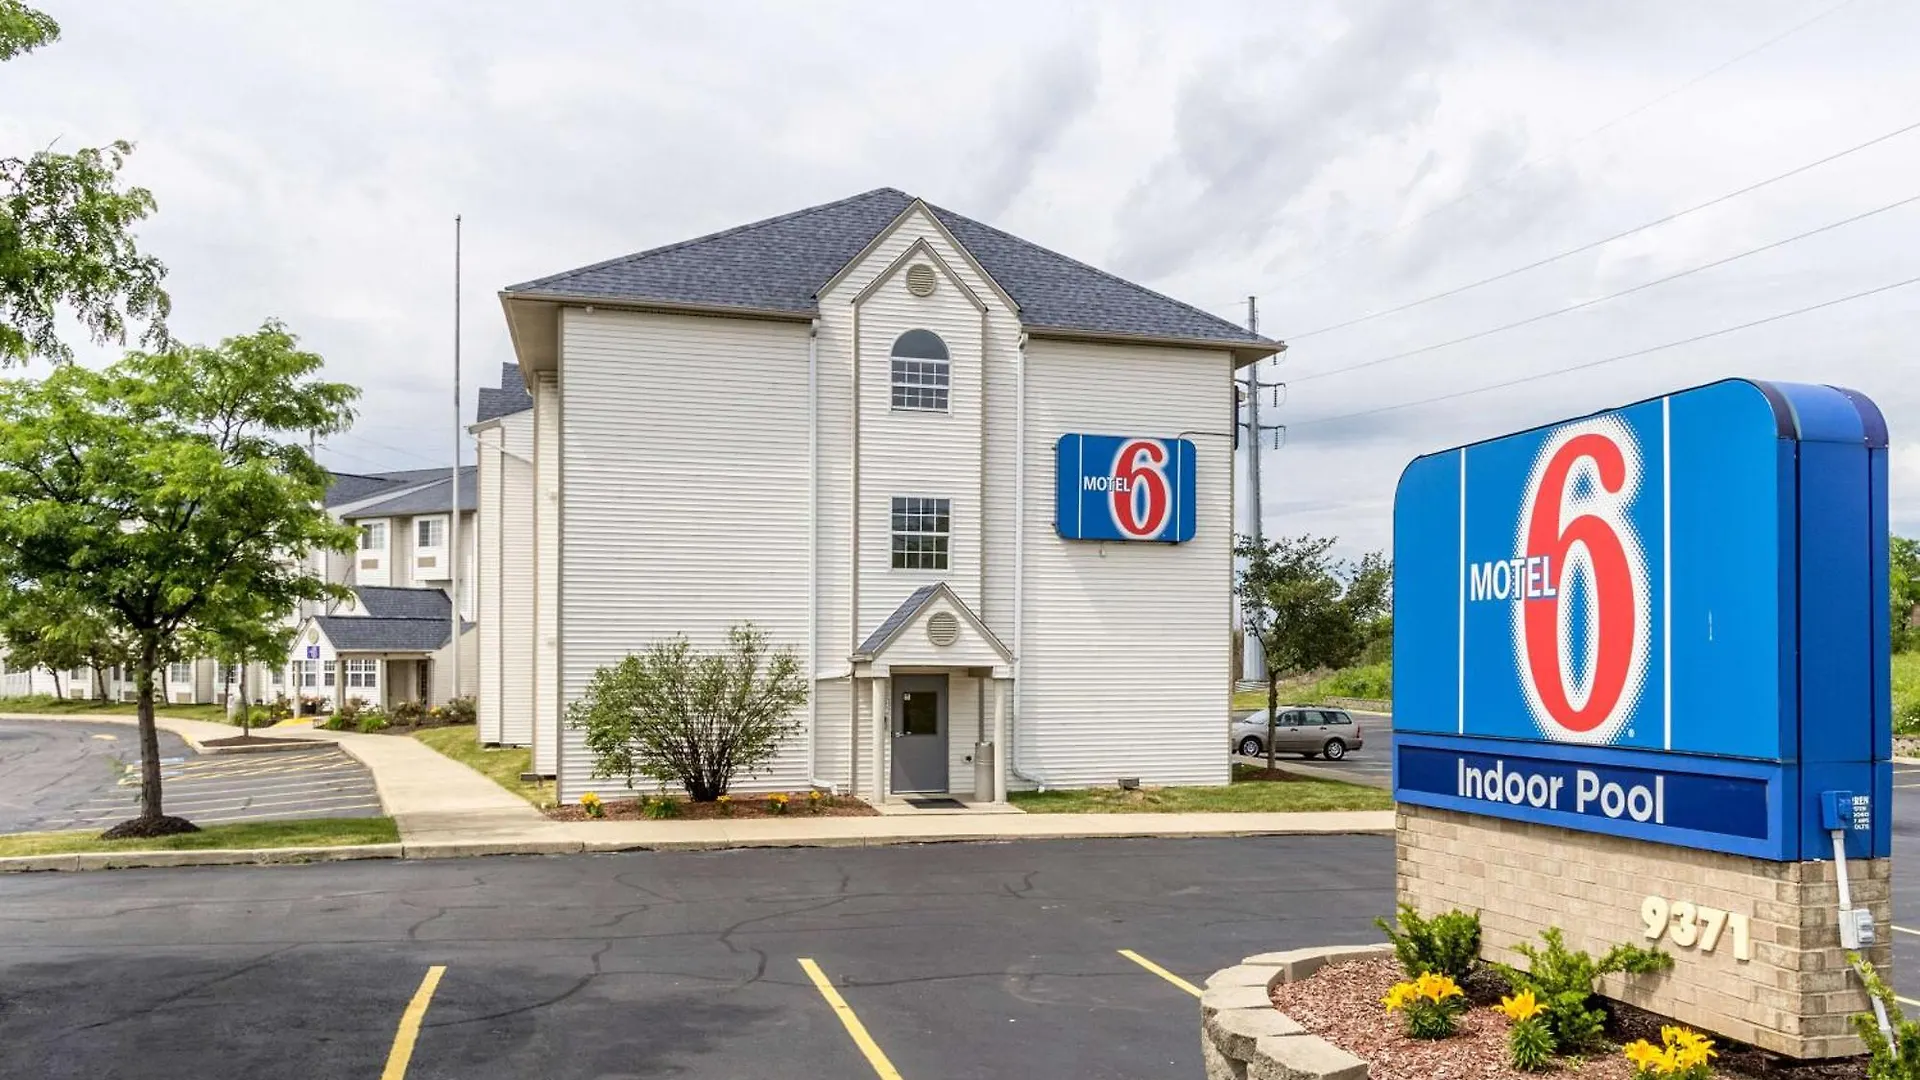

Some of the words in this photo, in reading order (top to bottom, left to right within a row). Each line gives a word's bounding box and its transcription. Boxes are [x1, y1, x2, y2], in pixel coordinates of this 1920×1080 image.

[1083, 476, 1131, 493] MOTEL
[1112, 440, 1168, 537] 6
[1470, 555, 1557, 602] MOTEL
[1522, 430, 1638, 736] 6
[1458, 757, 1564, 810] Indoor
[1576, 769, 1664, 825] Pool
[1641, 895, 1750, 961] 9371
